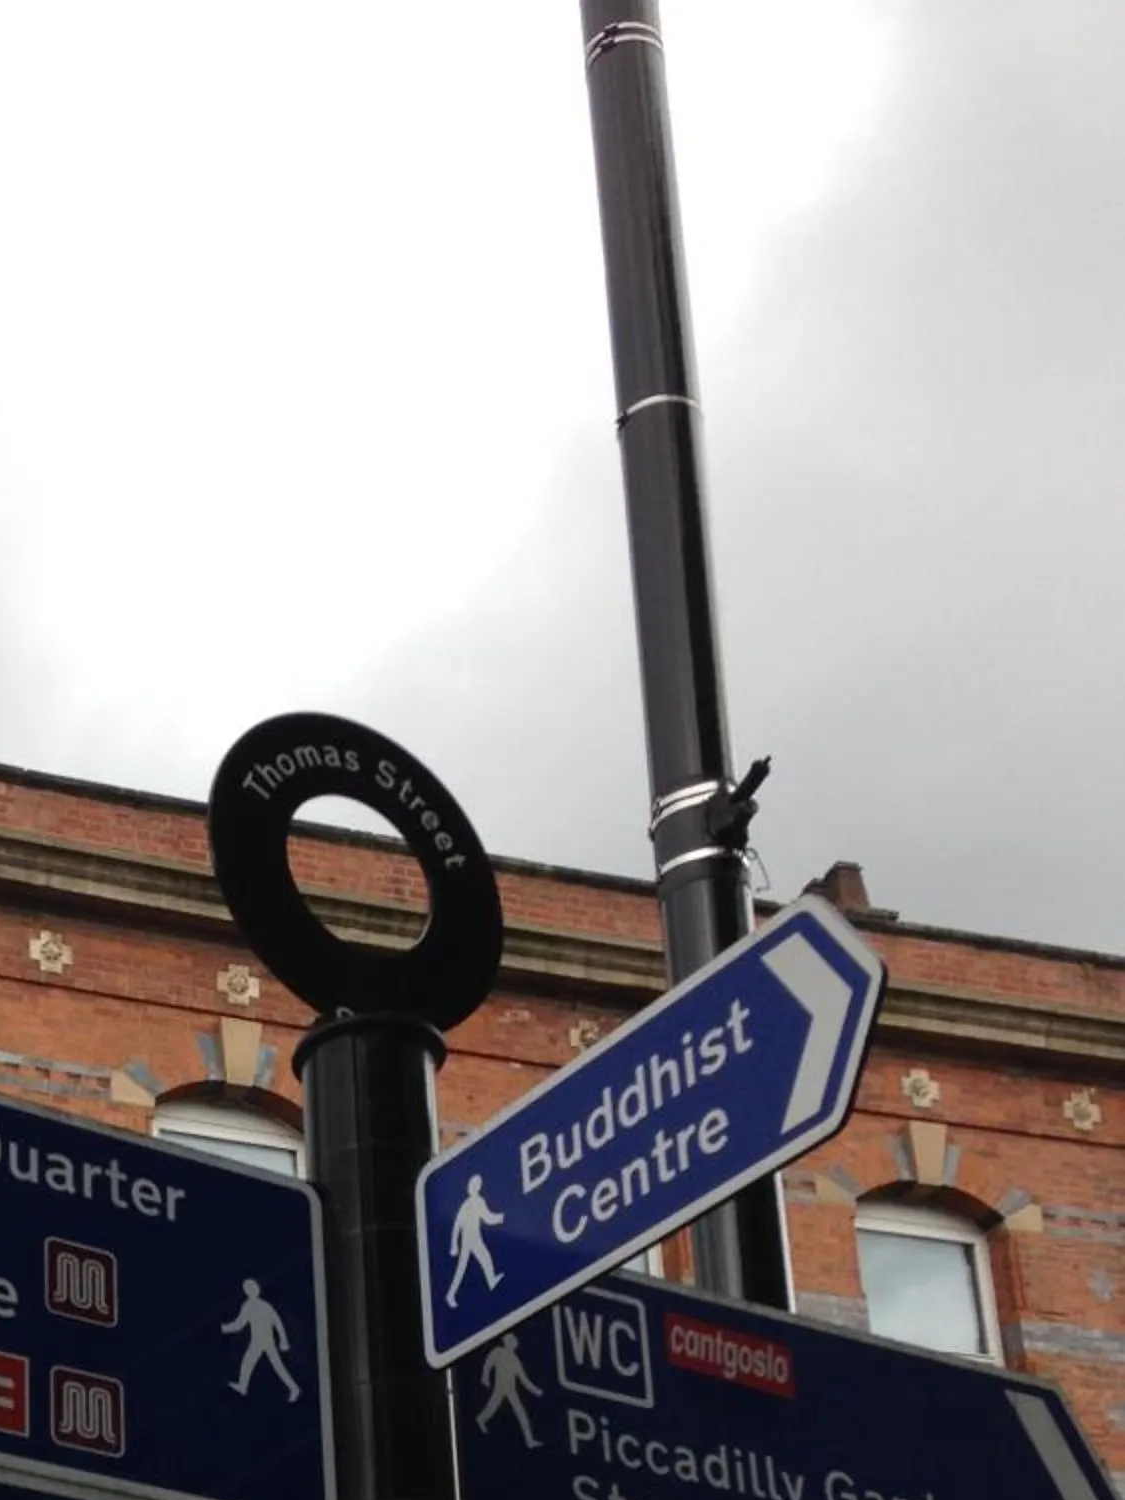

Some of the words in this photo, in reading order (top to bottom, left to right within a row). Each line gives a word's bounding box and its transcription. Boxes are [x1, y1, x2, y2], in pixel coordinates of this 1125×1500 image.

[242, 745, 360, 799] Thomas
[374, 760, 466, 868] Street
[519, 999, 753, 1194] Buddhist
[552, 1108, 729, 1243] Centre
[563, 1306, 640, 1377] WC
[670, 1325, 788, 1384] cantgoslo
